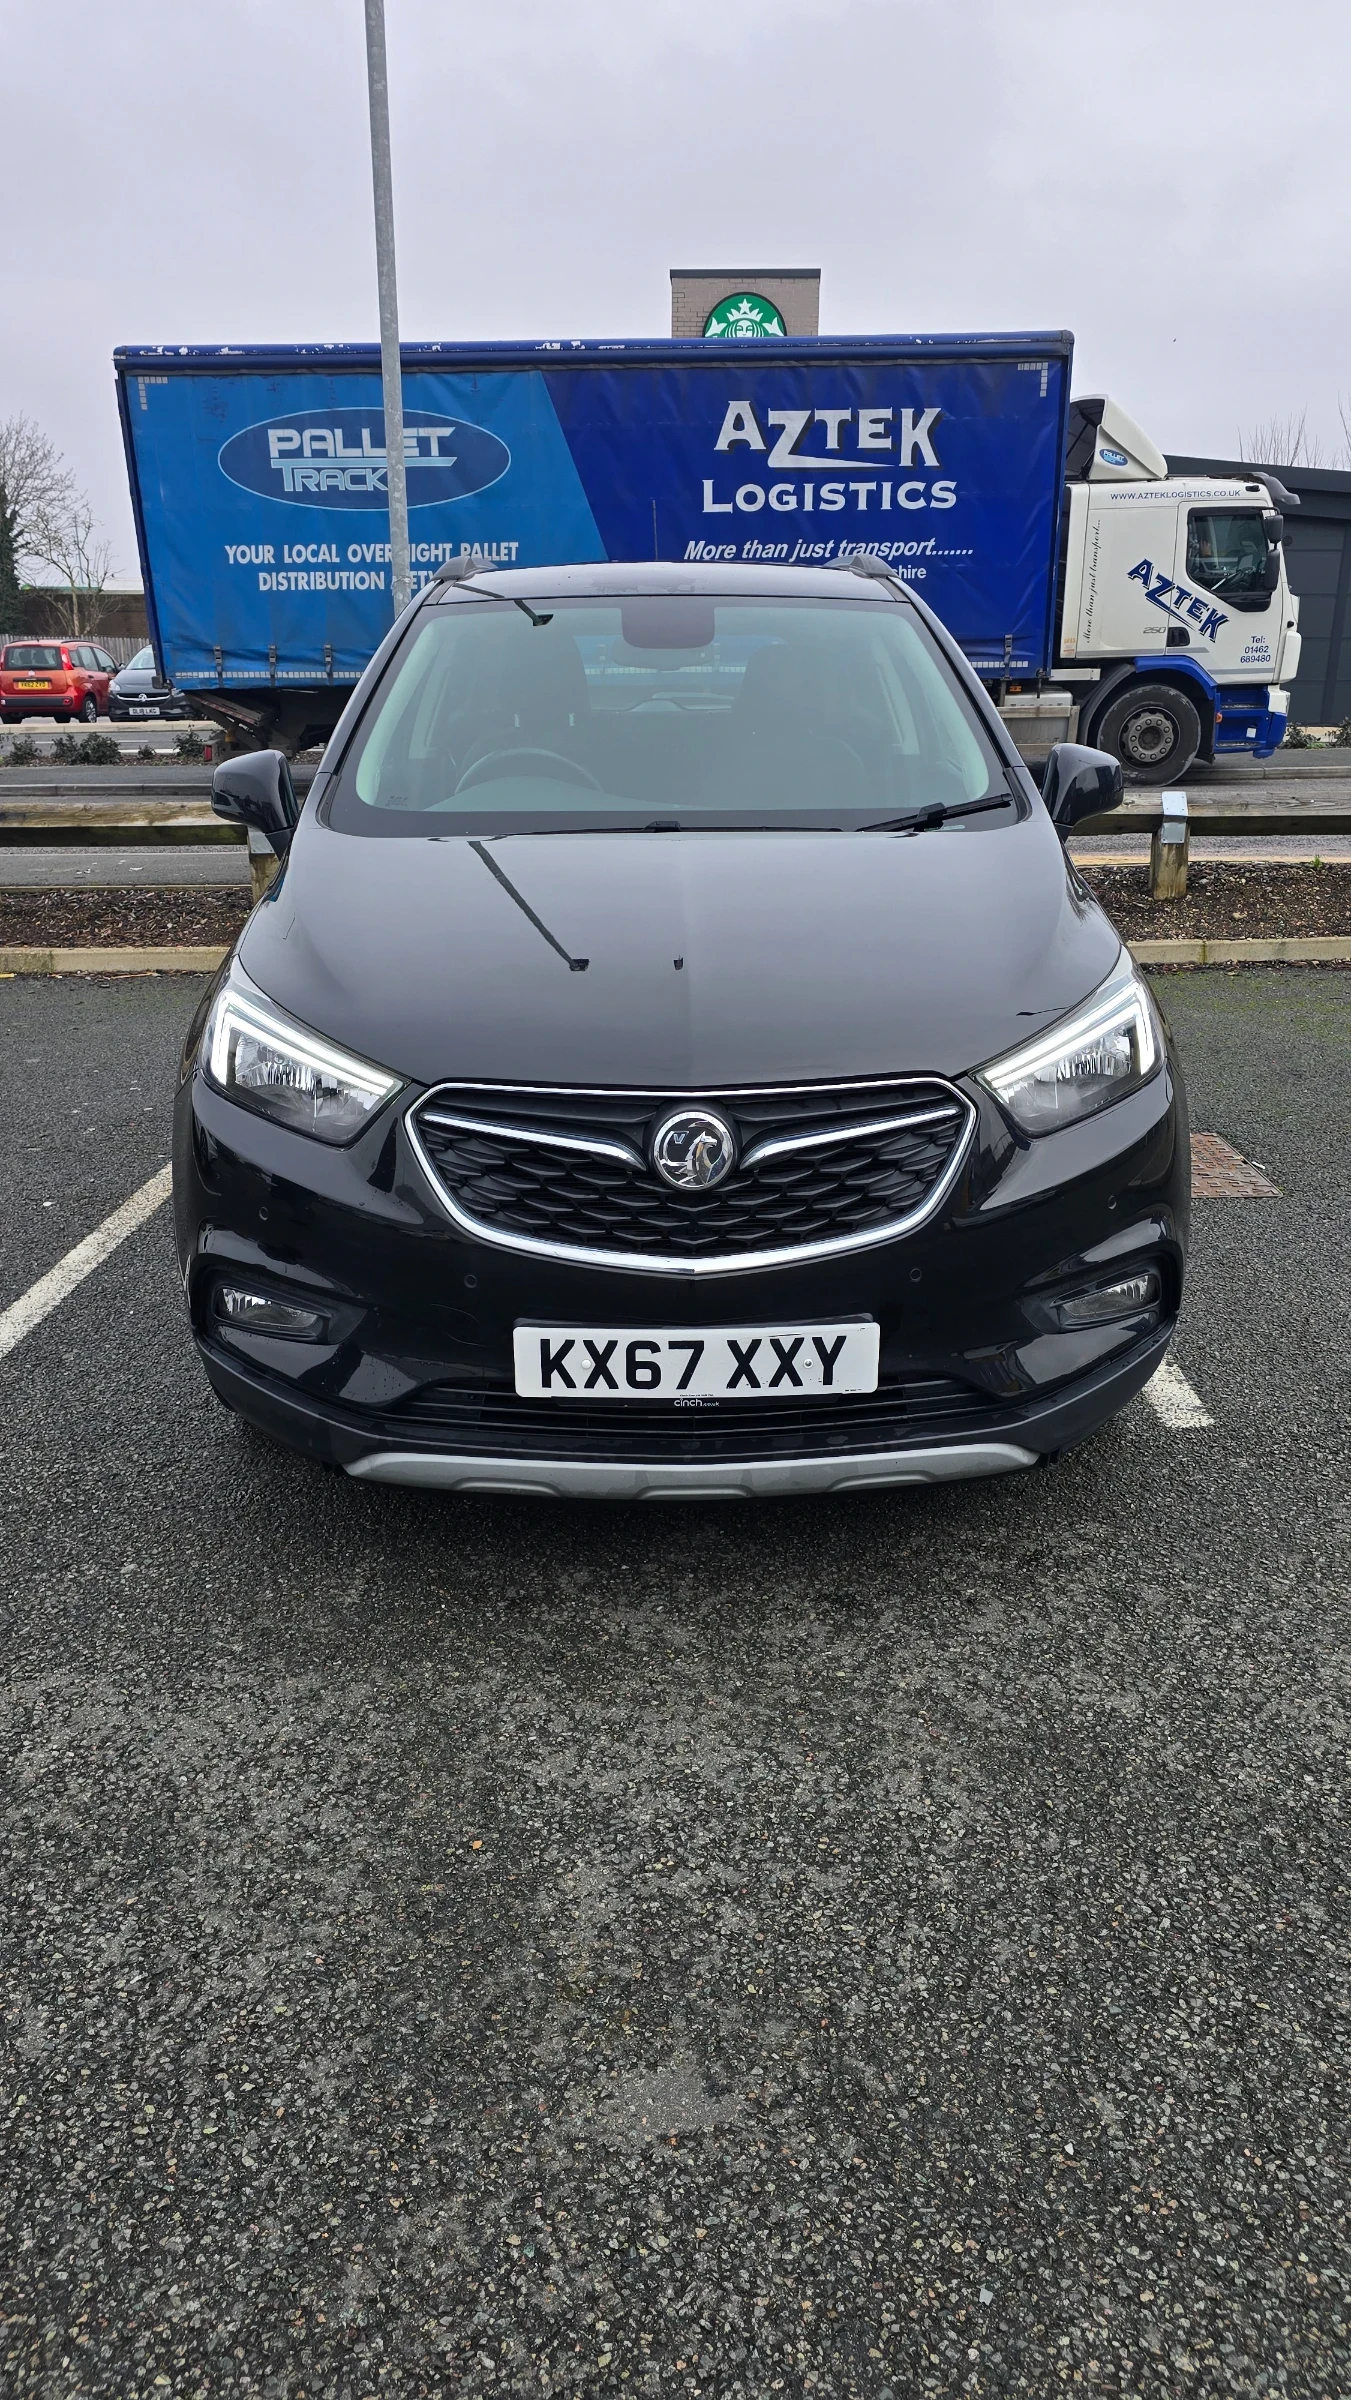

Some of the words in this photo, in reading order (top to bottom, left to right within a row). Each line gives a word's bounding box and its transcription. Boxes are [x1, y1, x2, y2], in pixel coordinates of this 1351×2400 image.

[267, 427, 456, 458] PALLET
[713, 400, 943, 468] AZTEK
[270, 457, 458, 492] TRACK
[701, 479, 958, 514] LOGISTICS
[1110, 489, 1241, 500] WWW.AZTEKLOGISTICS.CO.UK
[224, 544, 276, 564] YOUR
[283, 544, 340, 563] LOCAL
[347, 543, 453, 563] OVERIGHT
[460, 541, 519, 561] PALLET
[684, 540, 736, 560] More
[741, 539, 788, 559] than
[788, 538, 834, 561] just
[258, 571, 385, 591] DISTRIBUTION
[1126, 558, 1230, 643] AZTEK
[1244, 645, 1269, 654] 01462
[1251, 635, 1266, 643] Tel:
[1240, 654, 1271, 663] 689480
[540, 1338, 705, 1390] KX67
[726, 1335, 848, 1389] XXY
